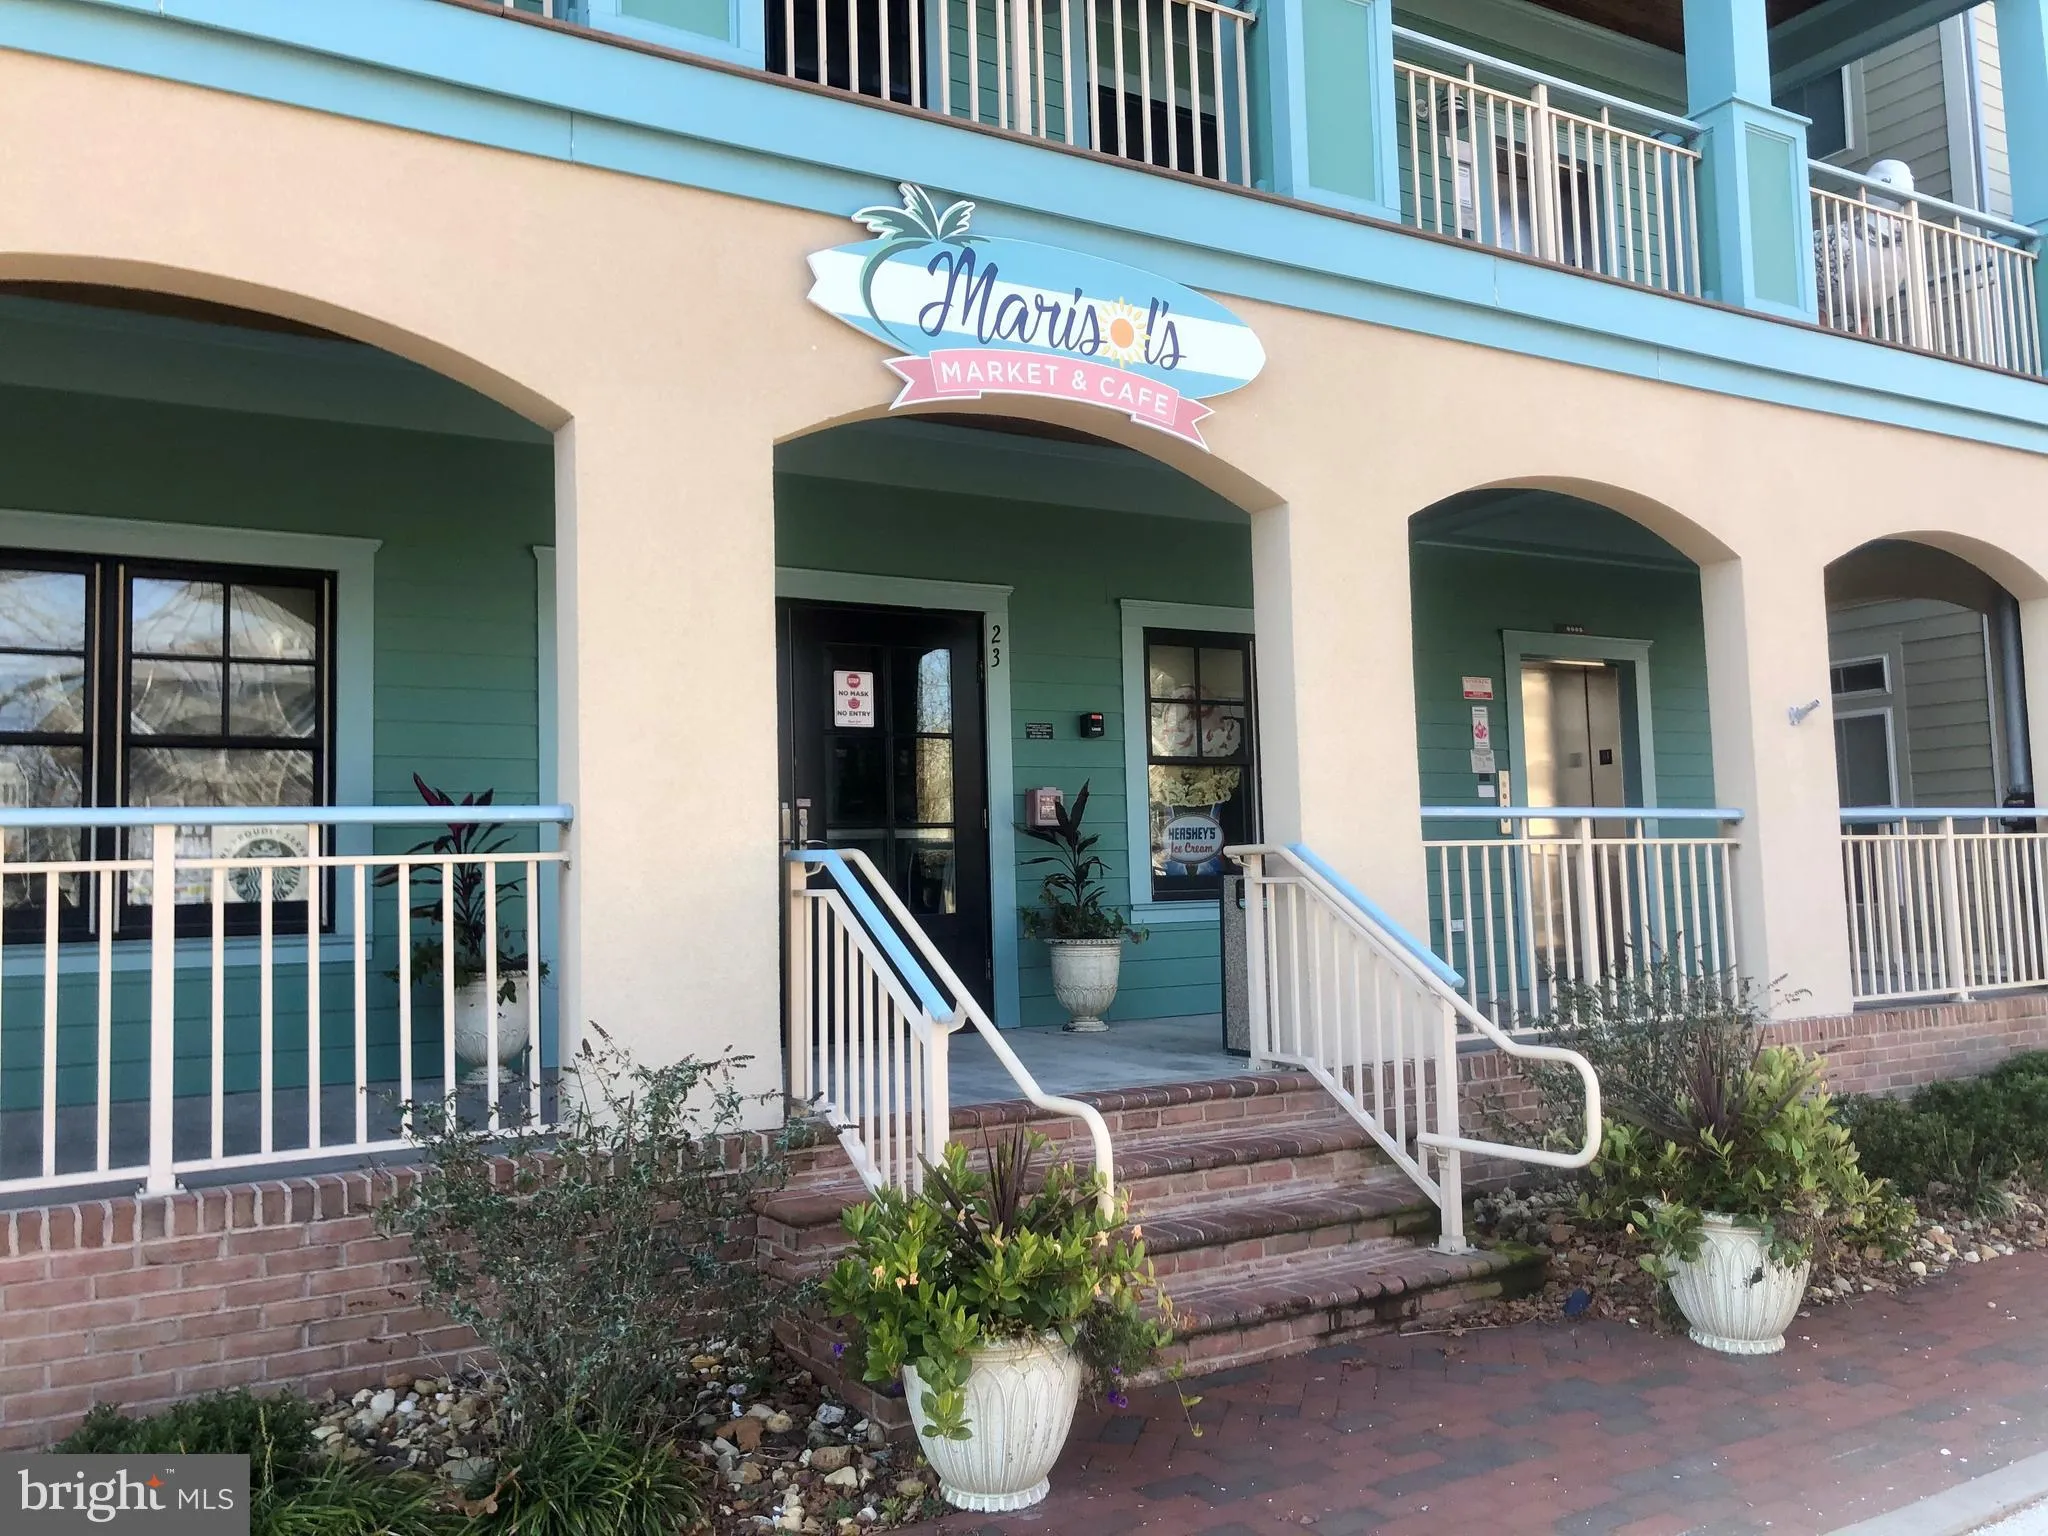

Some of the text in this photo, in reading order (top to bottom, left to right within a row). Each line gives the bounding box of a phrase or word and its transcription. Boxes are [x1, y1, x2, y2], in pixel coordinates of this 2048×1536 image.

[918, 246, 1187, 371] Marisol's
[941, 361, 1168, 415] MARKET & CAFE
[1168, 827, 1216, 840] HERSHEY'S
[1171, 841, 1213, 853] Ice Cream
